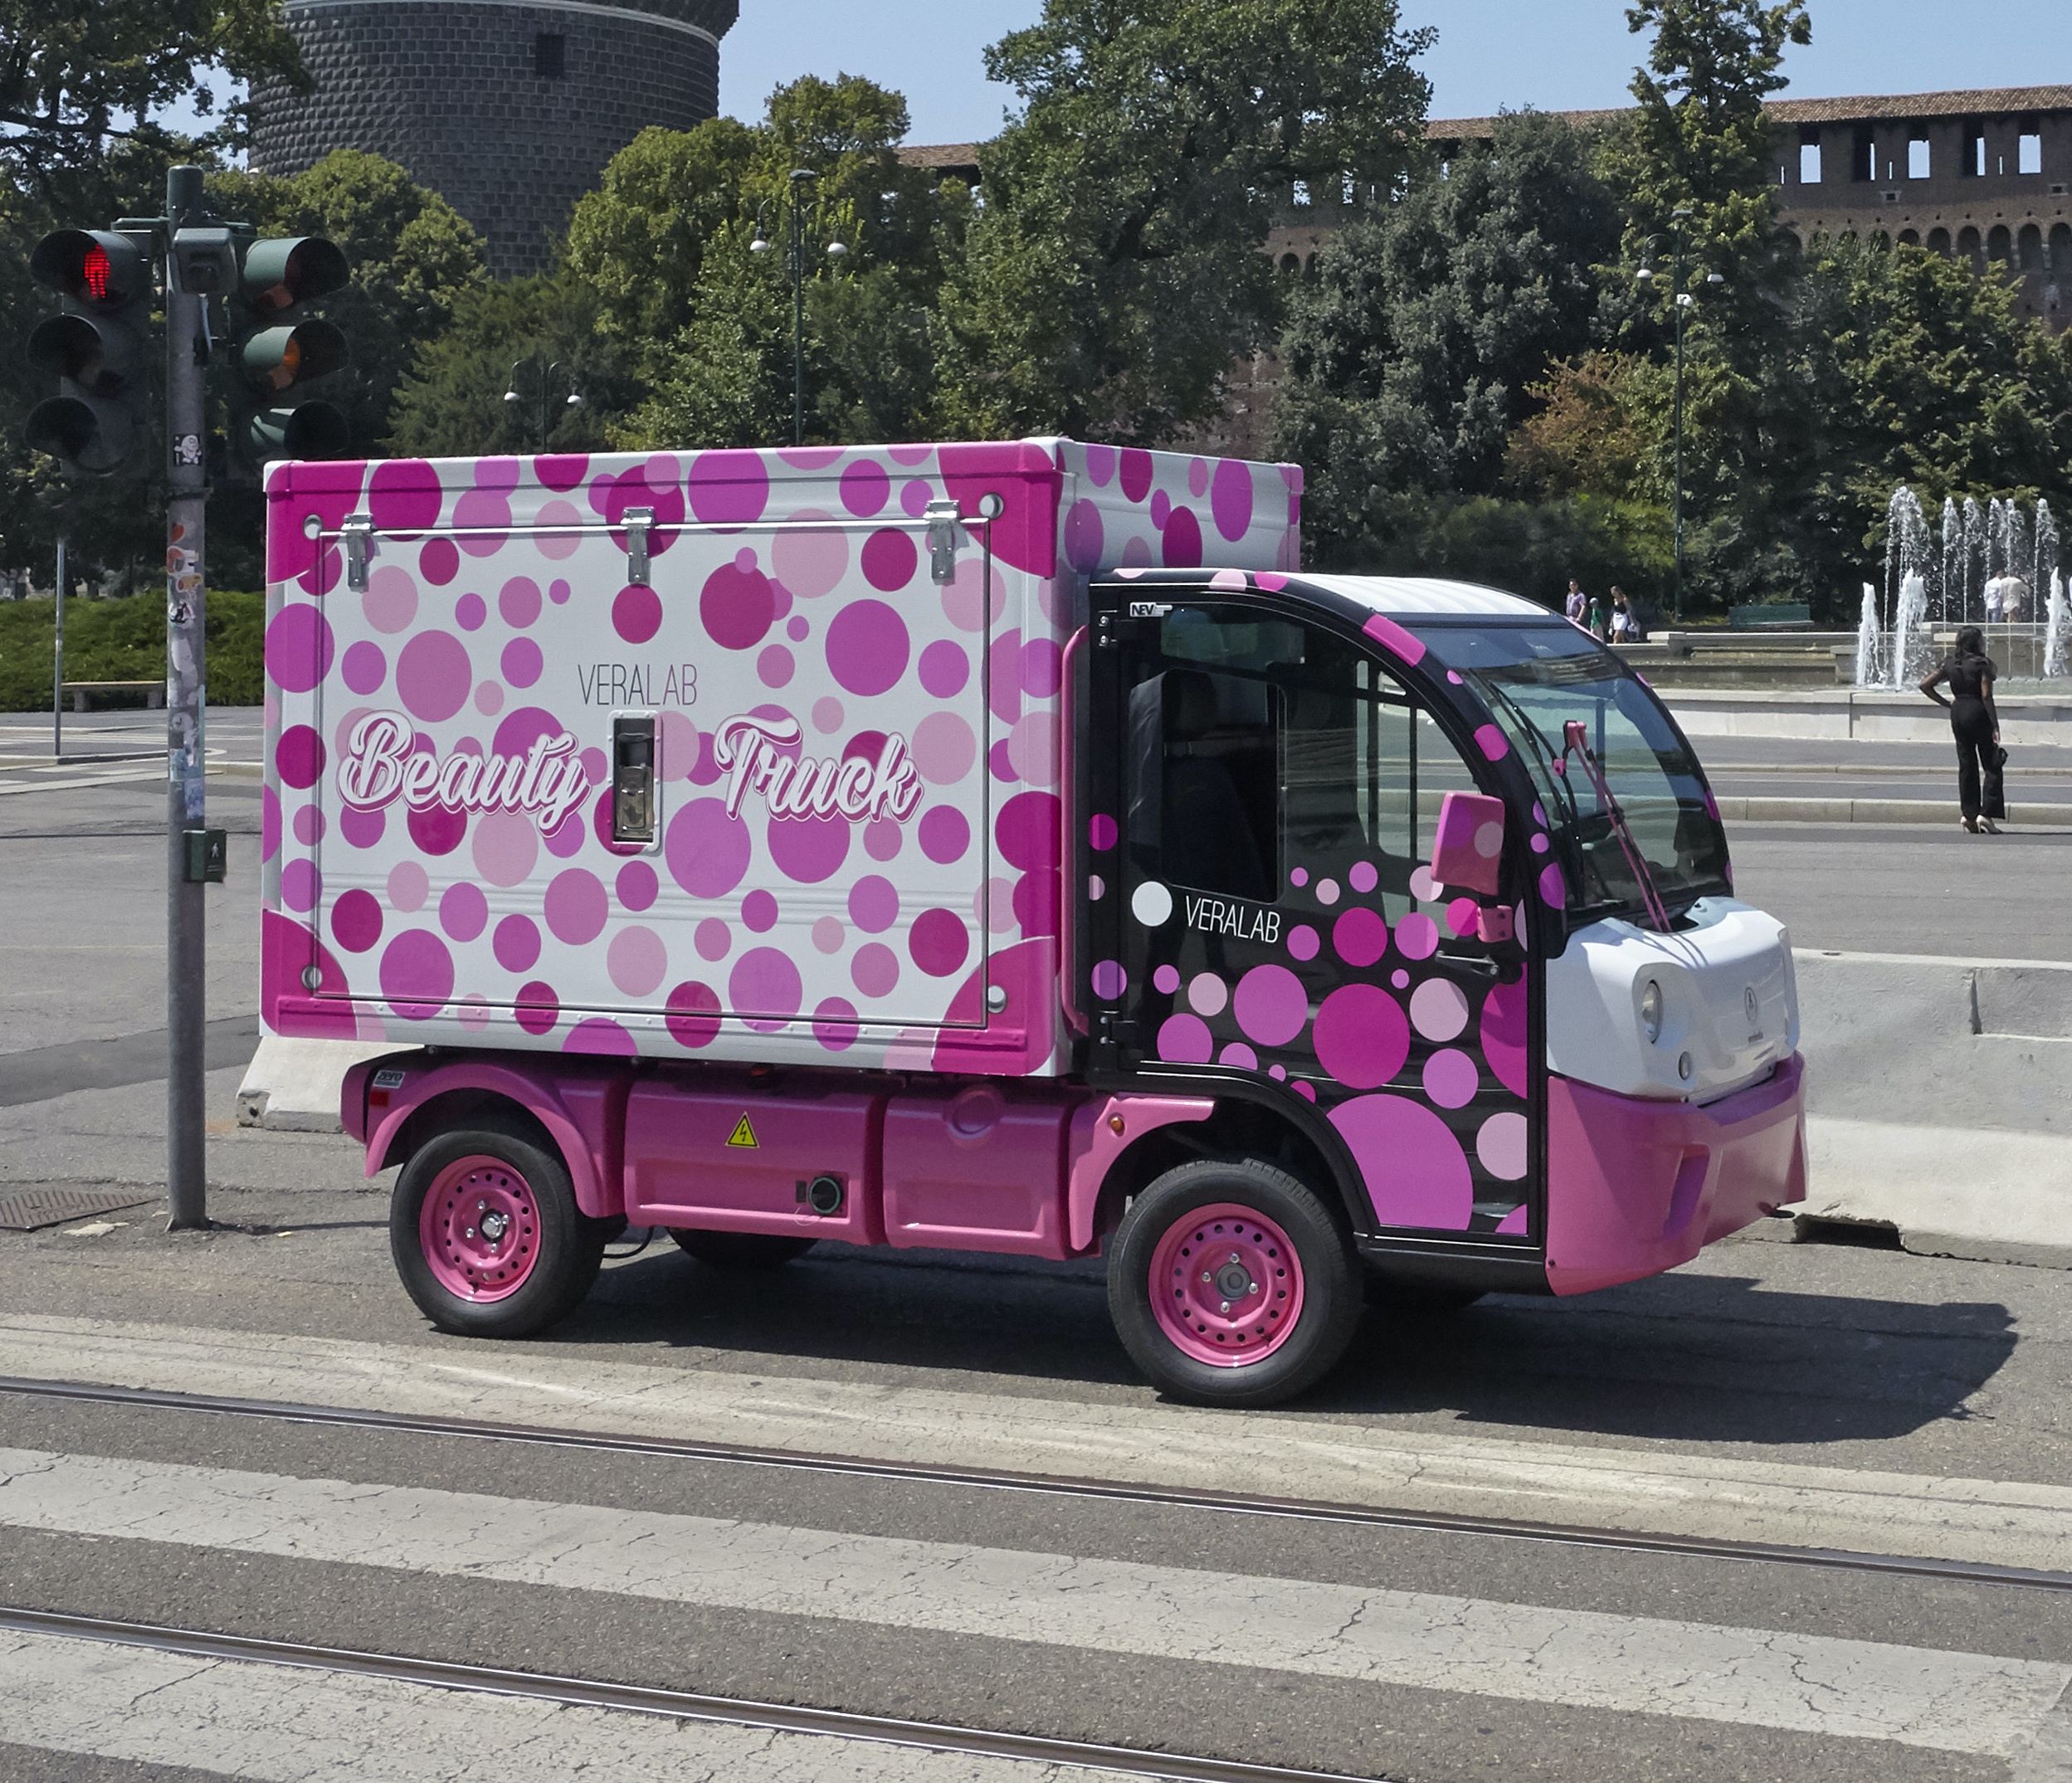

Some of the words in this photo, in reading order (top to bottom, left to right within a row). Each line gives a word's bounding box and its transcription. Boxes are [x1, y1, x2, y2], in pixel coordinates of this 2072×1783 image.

[1132, 604, 1154, 616] NEV
[578, 664, 698, 705] VERALAB
[336, 709, 591, 837] Beauty
[714, 714, 924, 823] Truck
[1186, 895, 1280, 943] VERALAB
